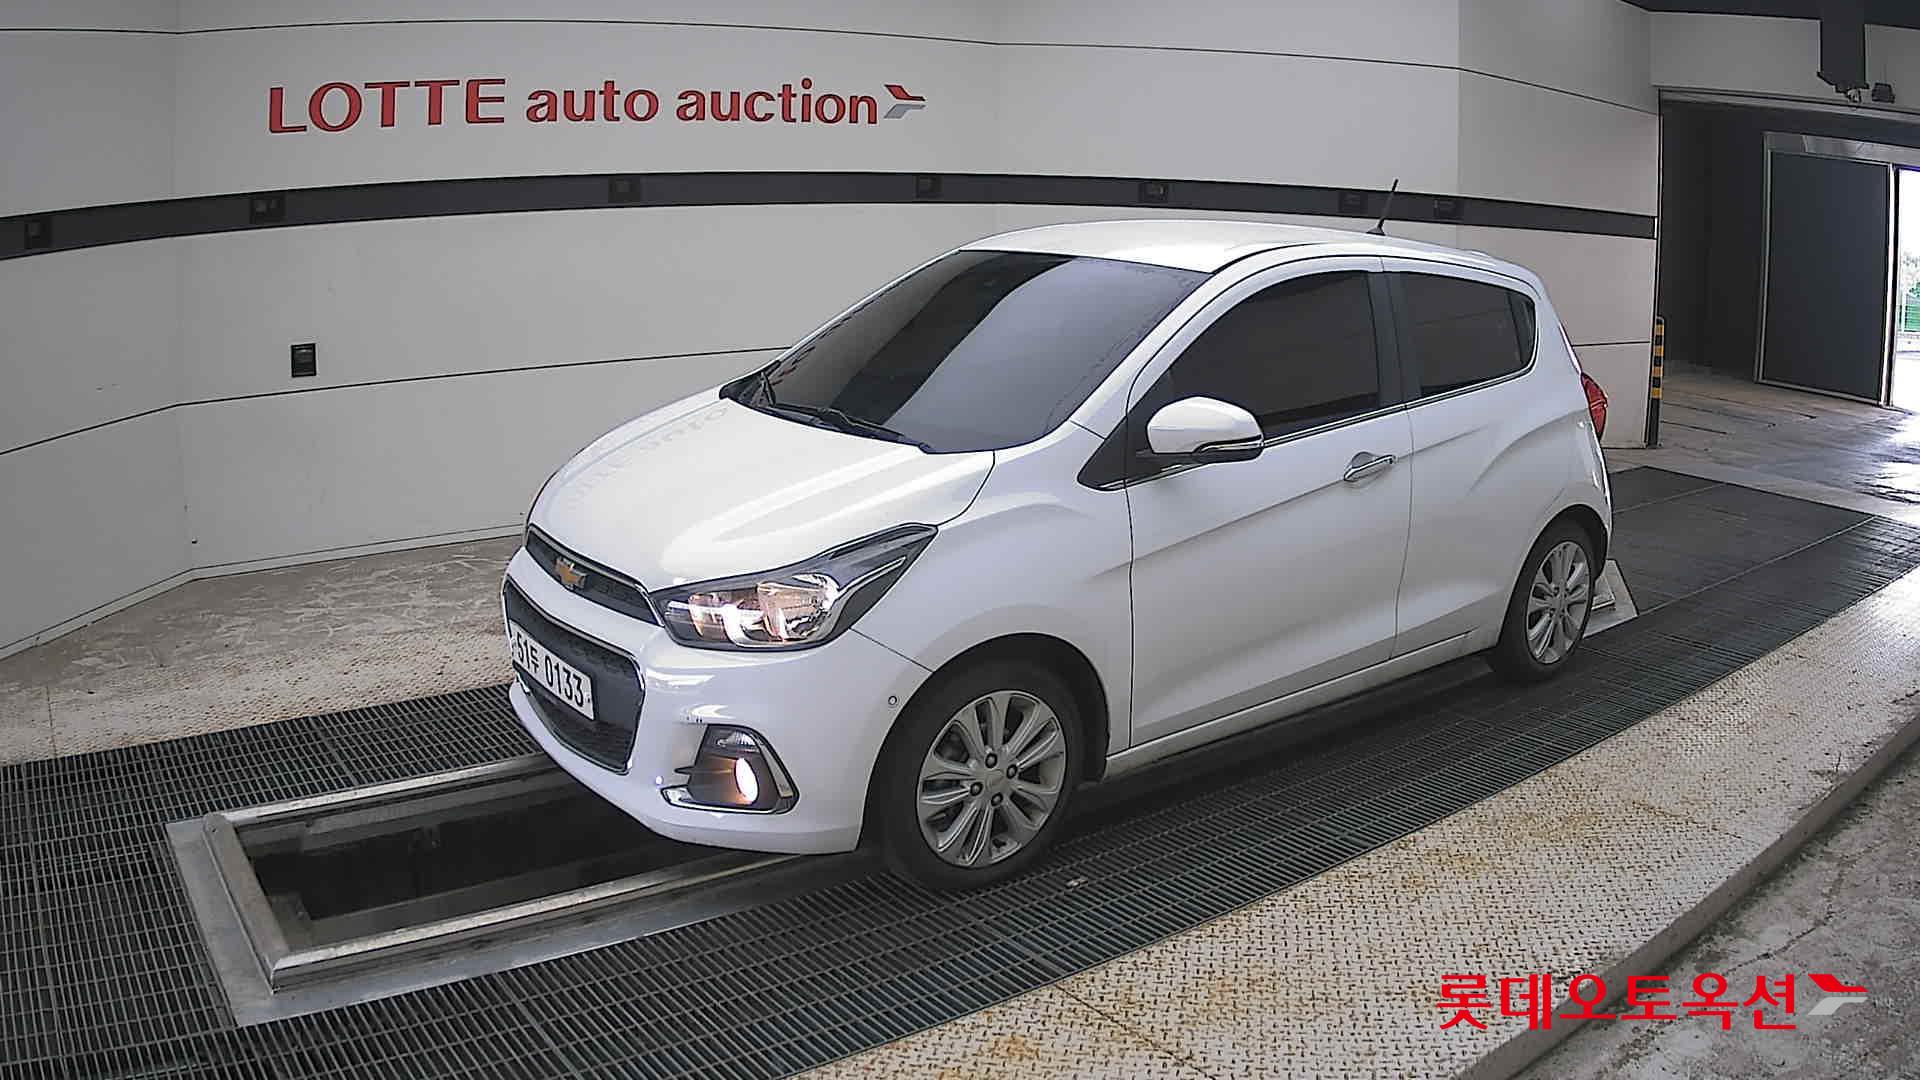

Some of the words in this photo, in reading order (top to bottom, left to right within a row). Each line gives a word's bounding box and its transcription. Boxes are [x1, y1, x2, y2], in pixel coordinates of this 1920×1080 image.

[270, 79, 505, 133] LOTTE
[526, 81, 658, 123] auto
[677, 79, 878, 125] auction
[545, 655, 584, 707] 0133
